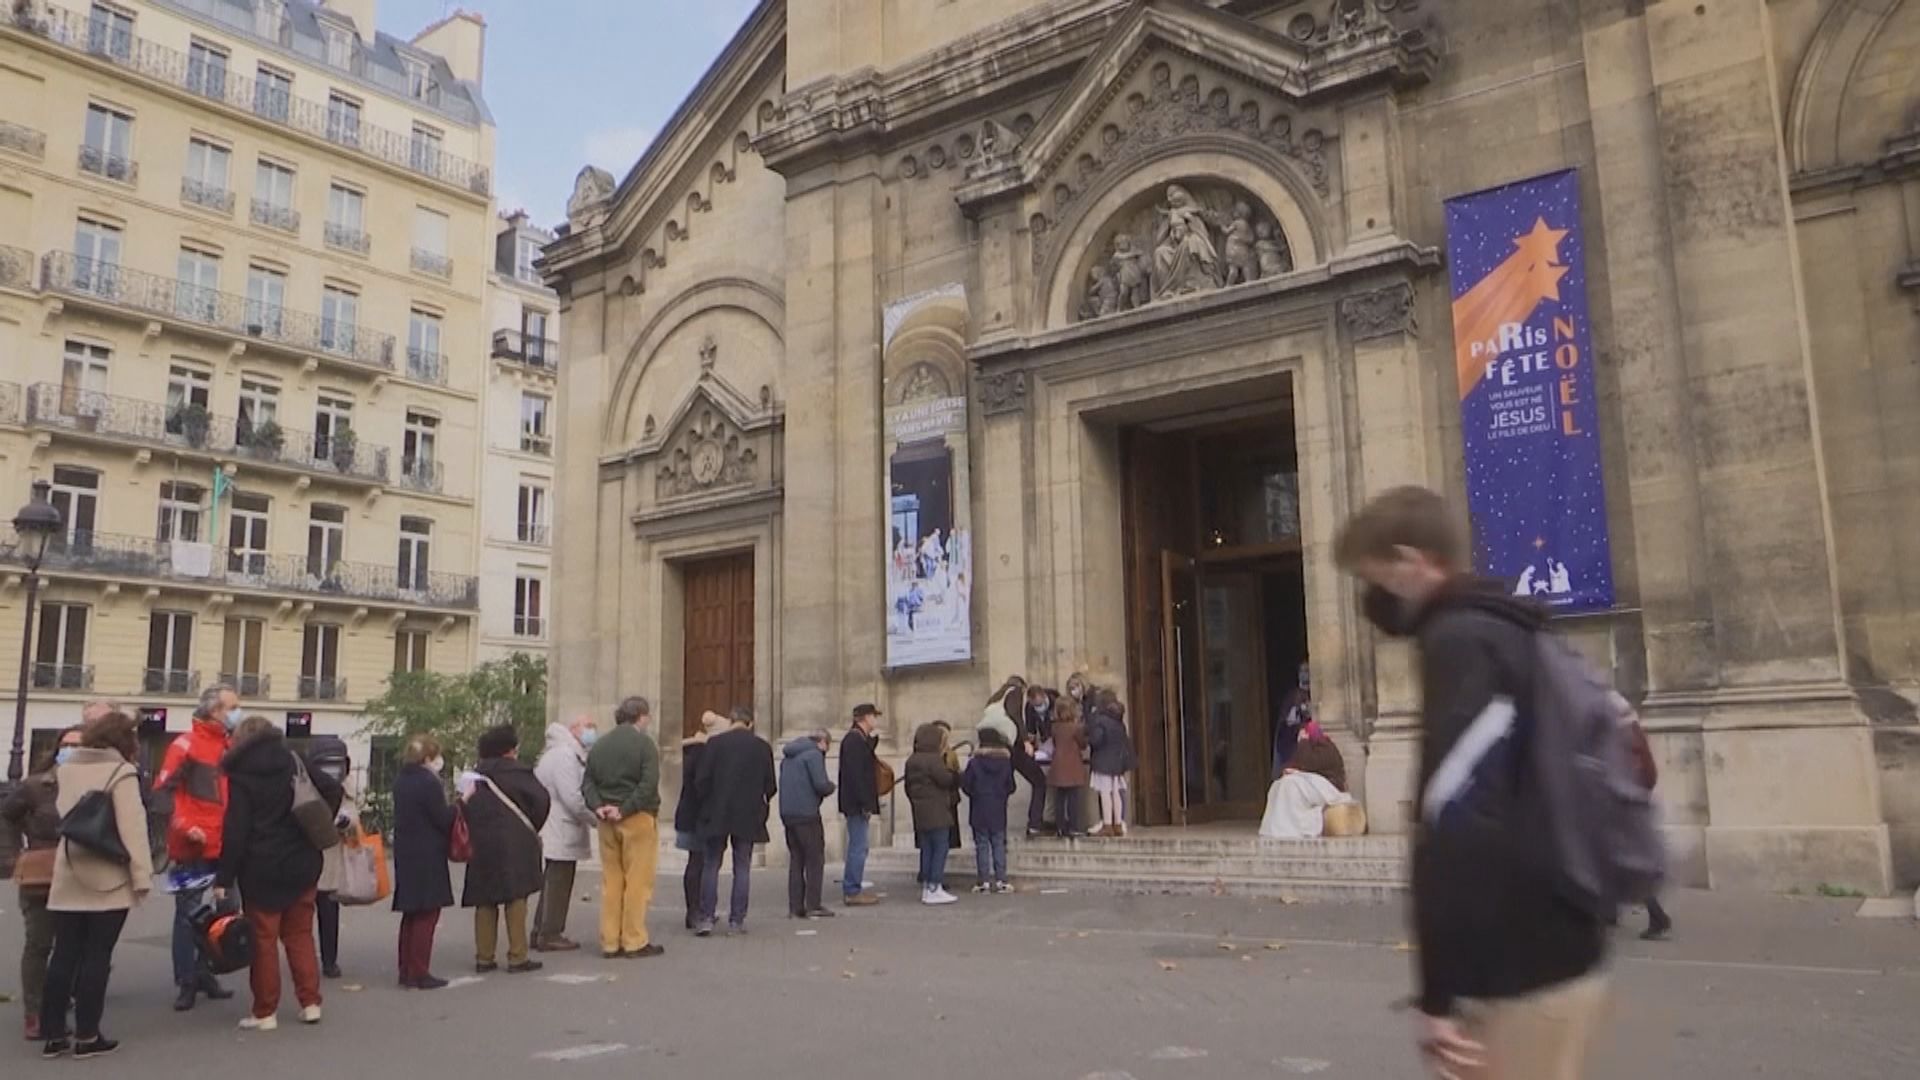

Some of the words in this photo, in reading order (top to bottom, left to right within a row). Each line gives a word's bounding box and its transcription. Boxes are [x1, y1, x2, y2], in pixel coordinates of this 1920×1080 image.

[1485, 350, 1550, 386] FÊTE
[1553, 314, 1582, 435] NOËL
[1489, 392, 1502, 400] UN
[1503, 384, 1543, 398] SAUVEUR
[1490, 401, 1513, 410] VOUS
[1514, 398, 1529, 407] EST
[1487, 430, 1498, 440] LE
[1498, 428, 1516, 438] FILS
[1516, 426, 1529, 435] DE
[1530, 422, 1551, 433] DIEU
